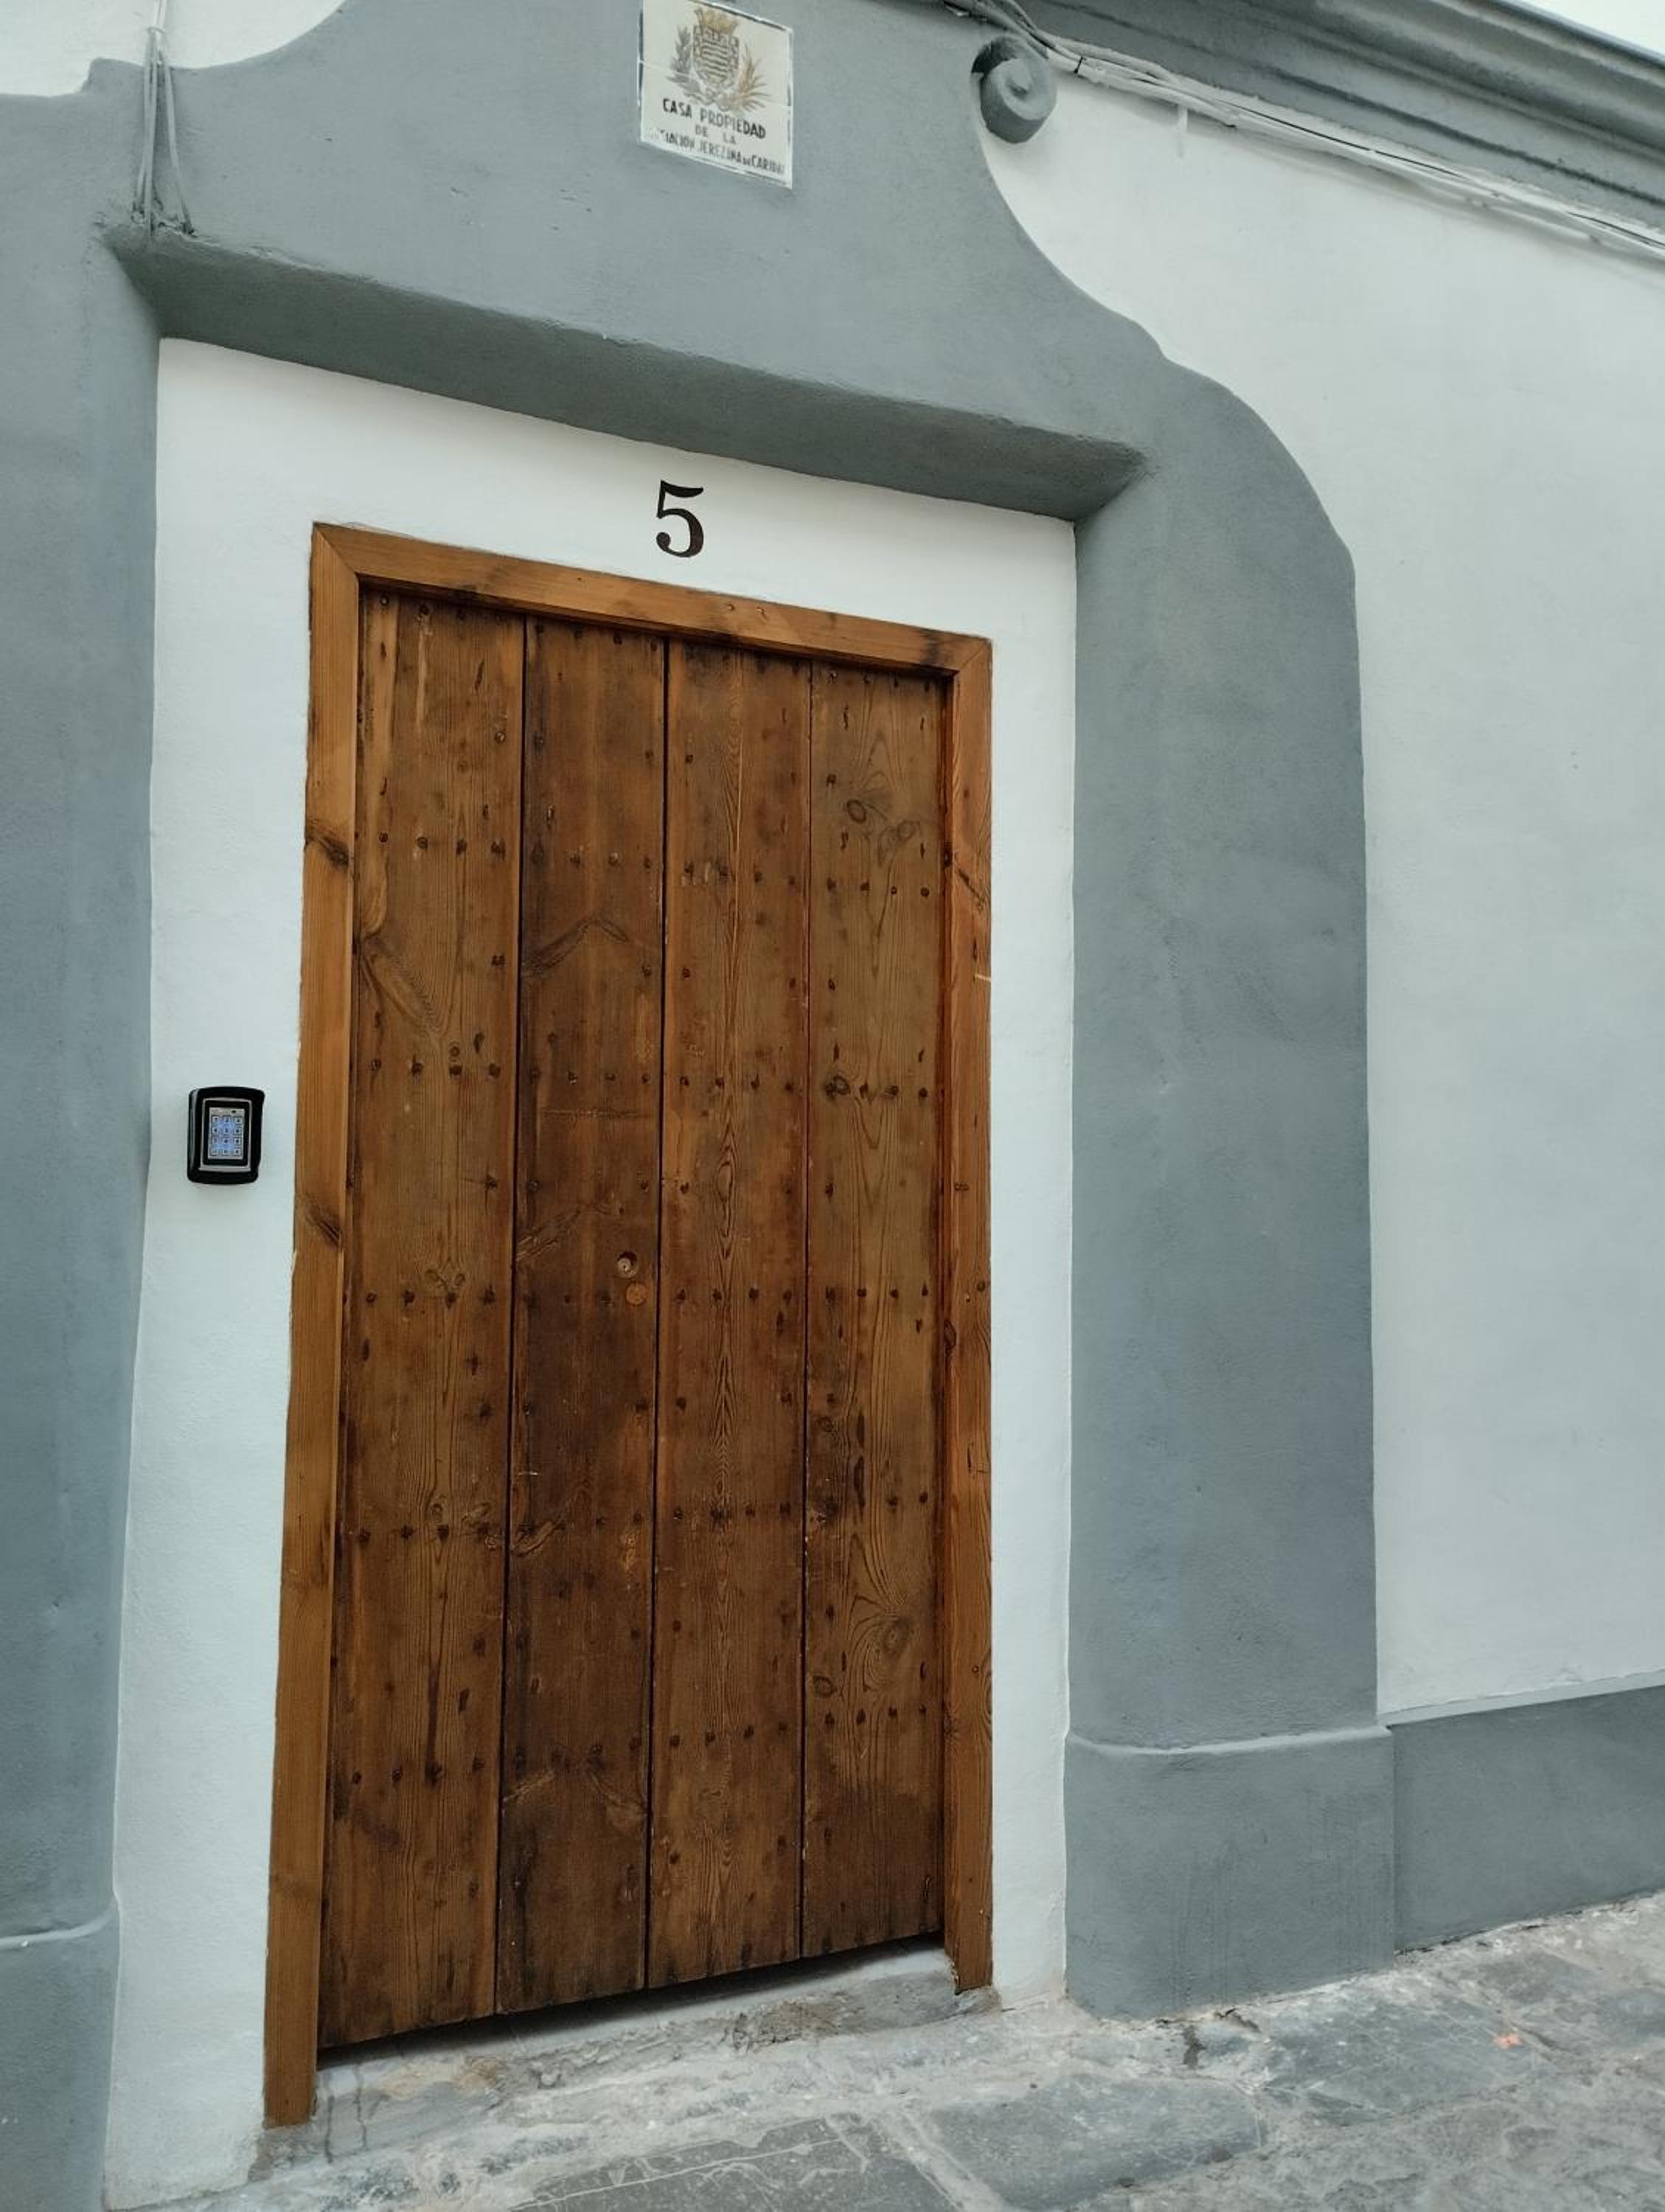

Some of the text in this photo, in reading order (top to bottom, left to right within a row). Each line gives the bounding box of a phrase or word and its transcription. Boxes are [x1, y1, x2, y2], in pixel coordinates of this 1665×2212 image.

[662, 97, 766, 139] CASA PROPIEDAD
[695, 124, 736, 145] DE LA
[656, 479, 703, 558] 5
